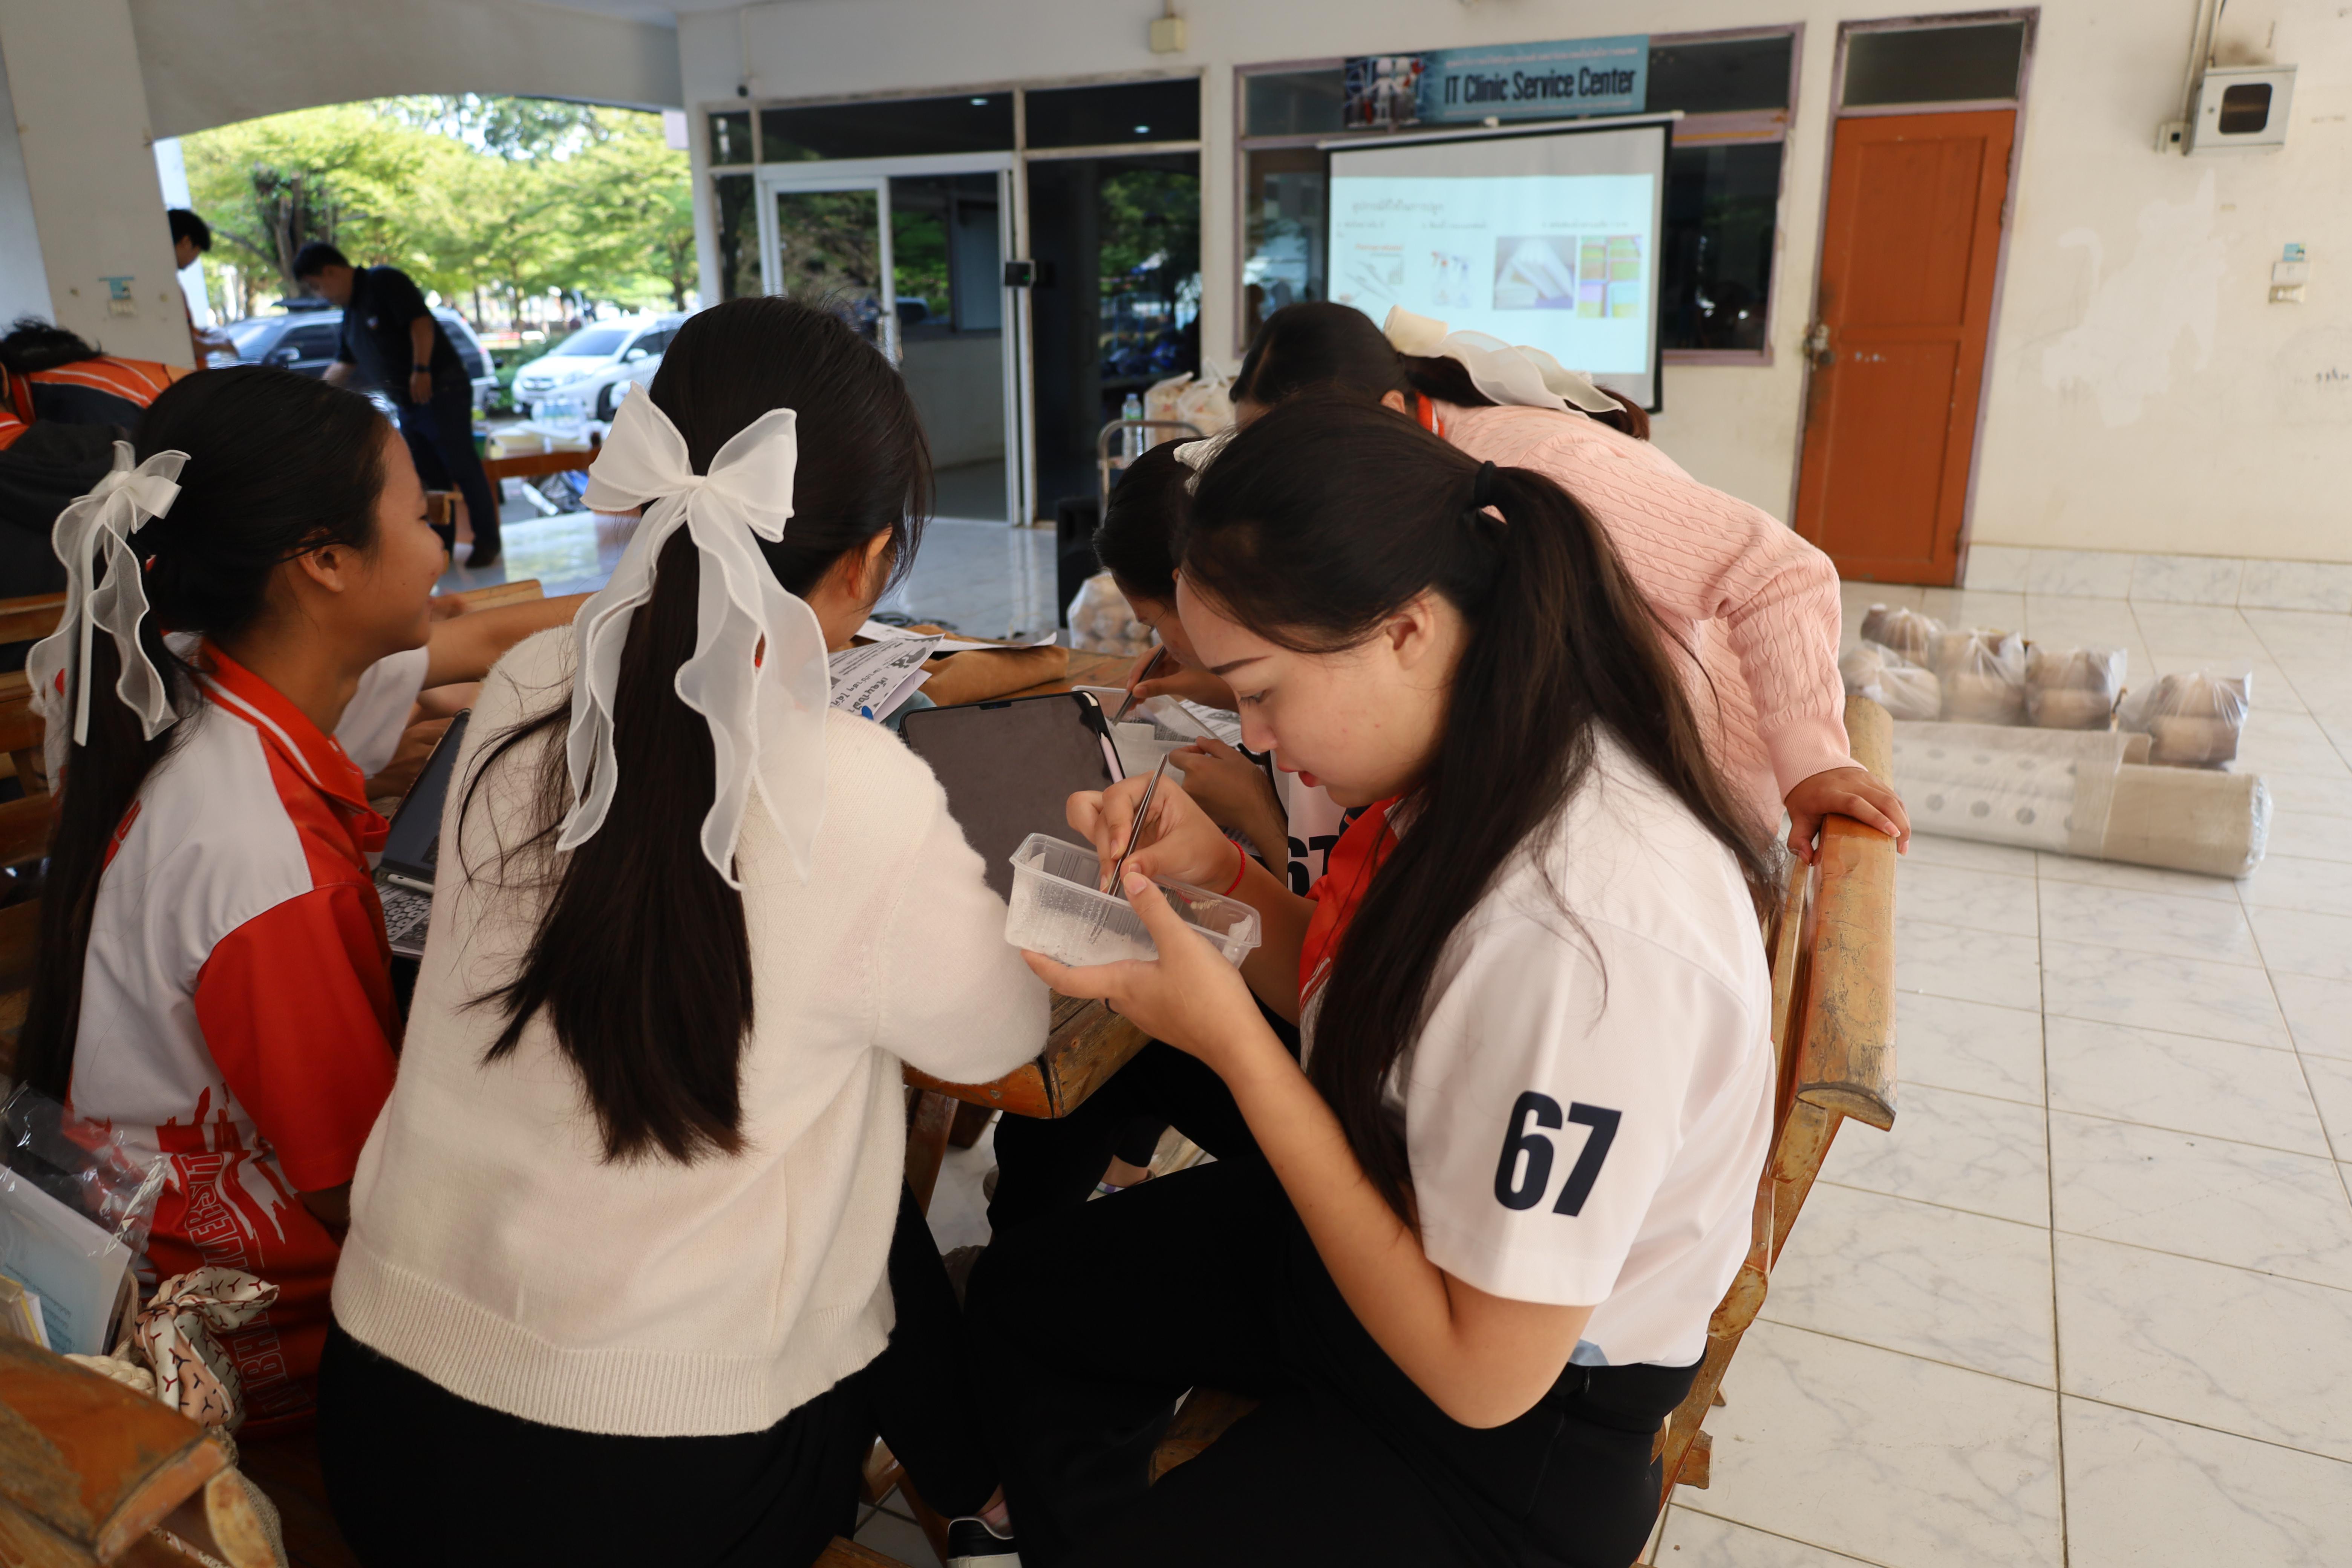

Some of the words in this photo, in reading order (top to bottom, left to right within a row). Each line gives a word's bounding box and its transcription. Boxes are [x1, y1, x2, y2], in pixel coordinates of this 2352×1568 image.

[1445, 75, 1459, 105] IT
[1464, 72, 1507, 104] Clinic
[1513, 68, 1574, 100] Service
[1579, 66, 1636, 97] Center
[1495, 1091, 1622, 1217] 67
